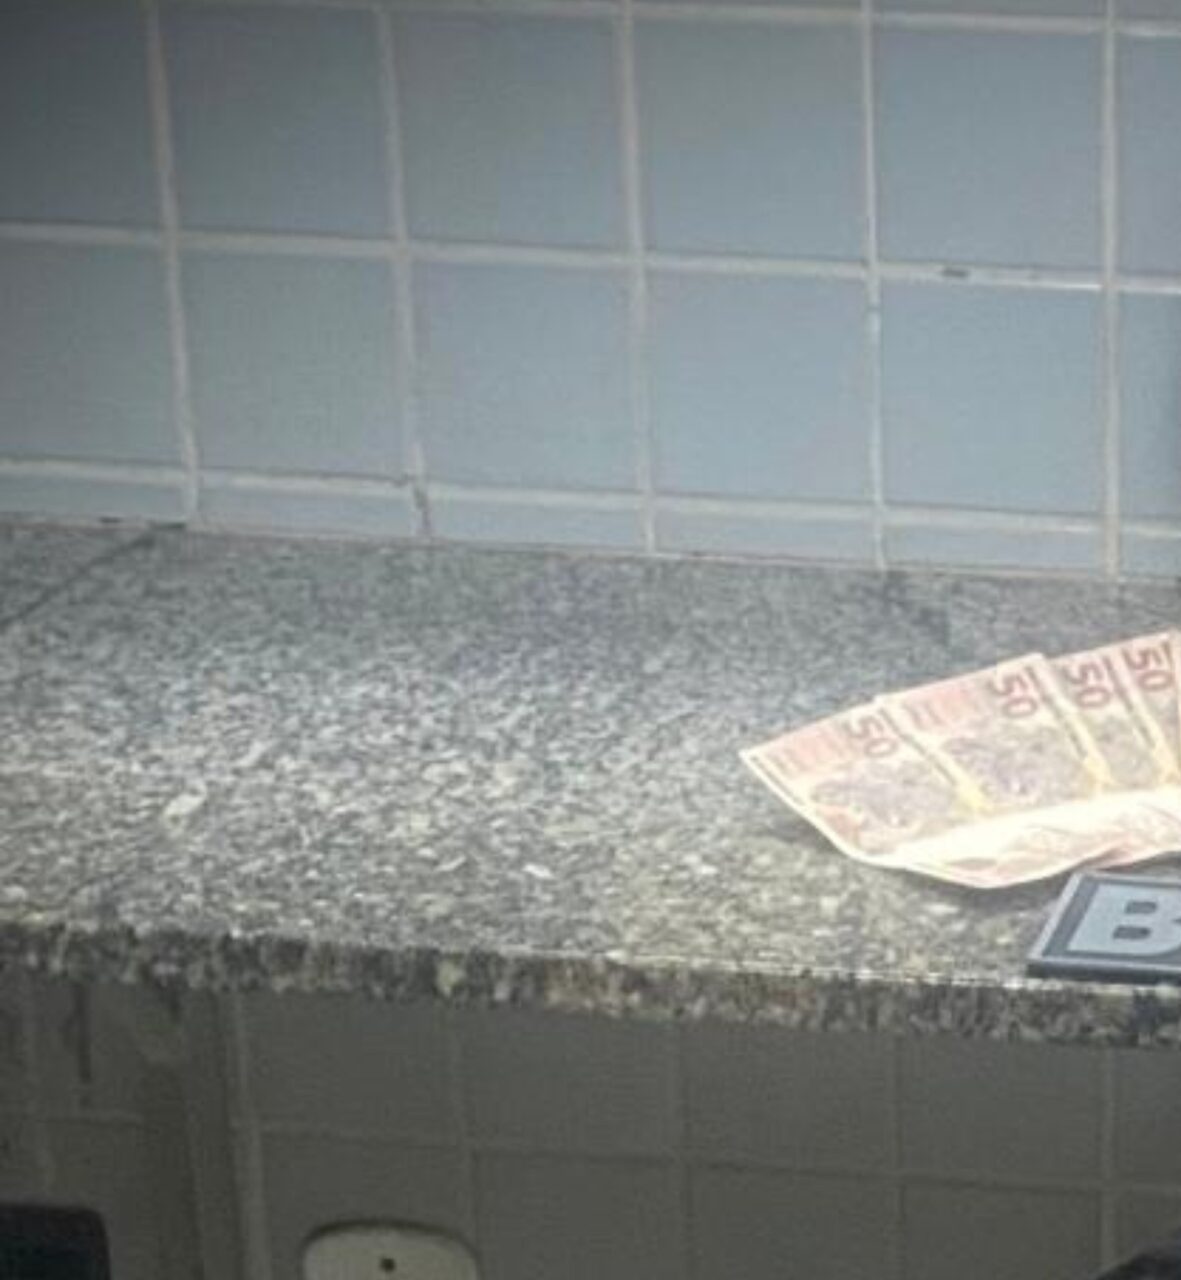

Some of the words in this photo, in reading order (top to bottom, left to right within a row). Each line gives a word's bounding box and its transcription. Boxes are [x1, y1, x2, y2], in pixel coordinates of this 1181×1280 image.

[1063, 660, 1114, 710] 50
[1121, 645, 1175, 693] 50
[989, 673, 1040, 719] 50
[846, 713, 899, 758] 50
